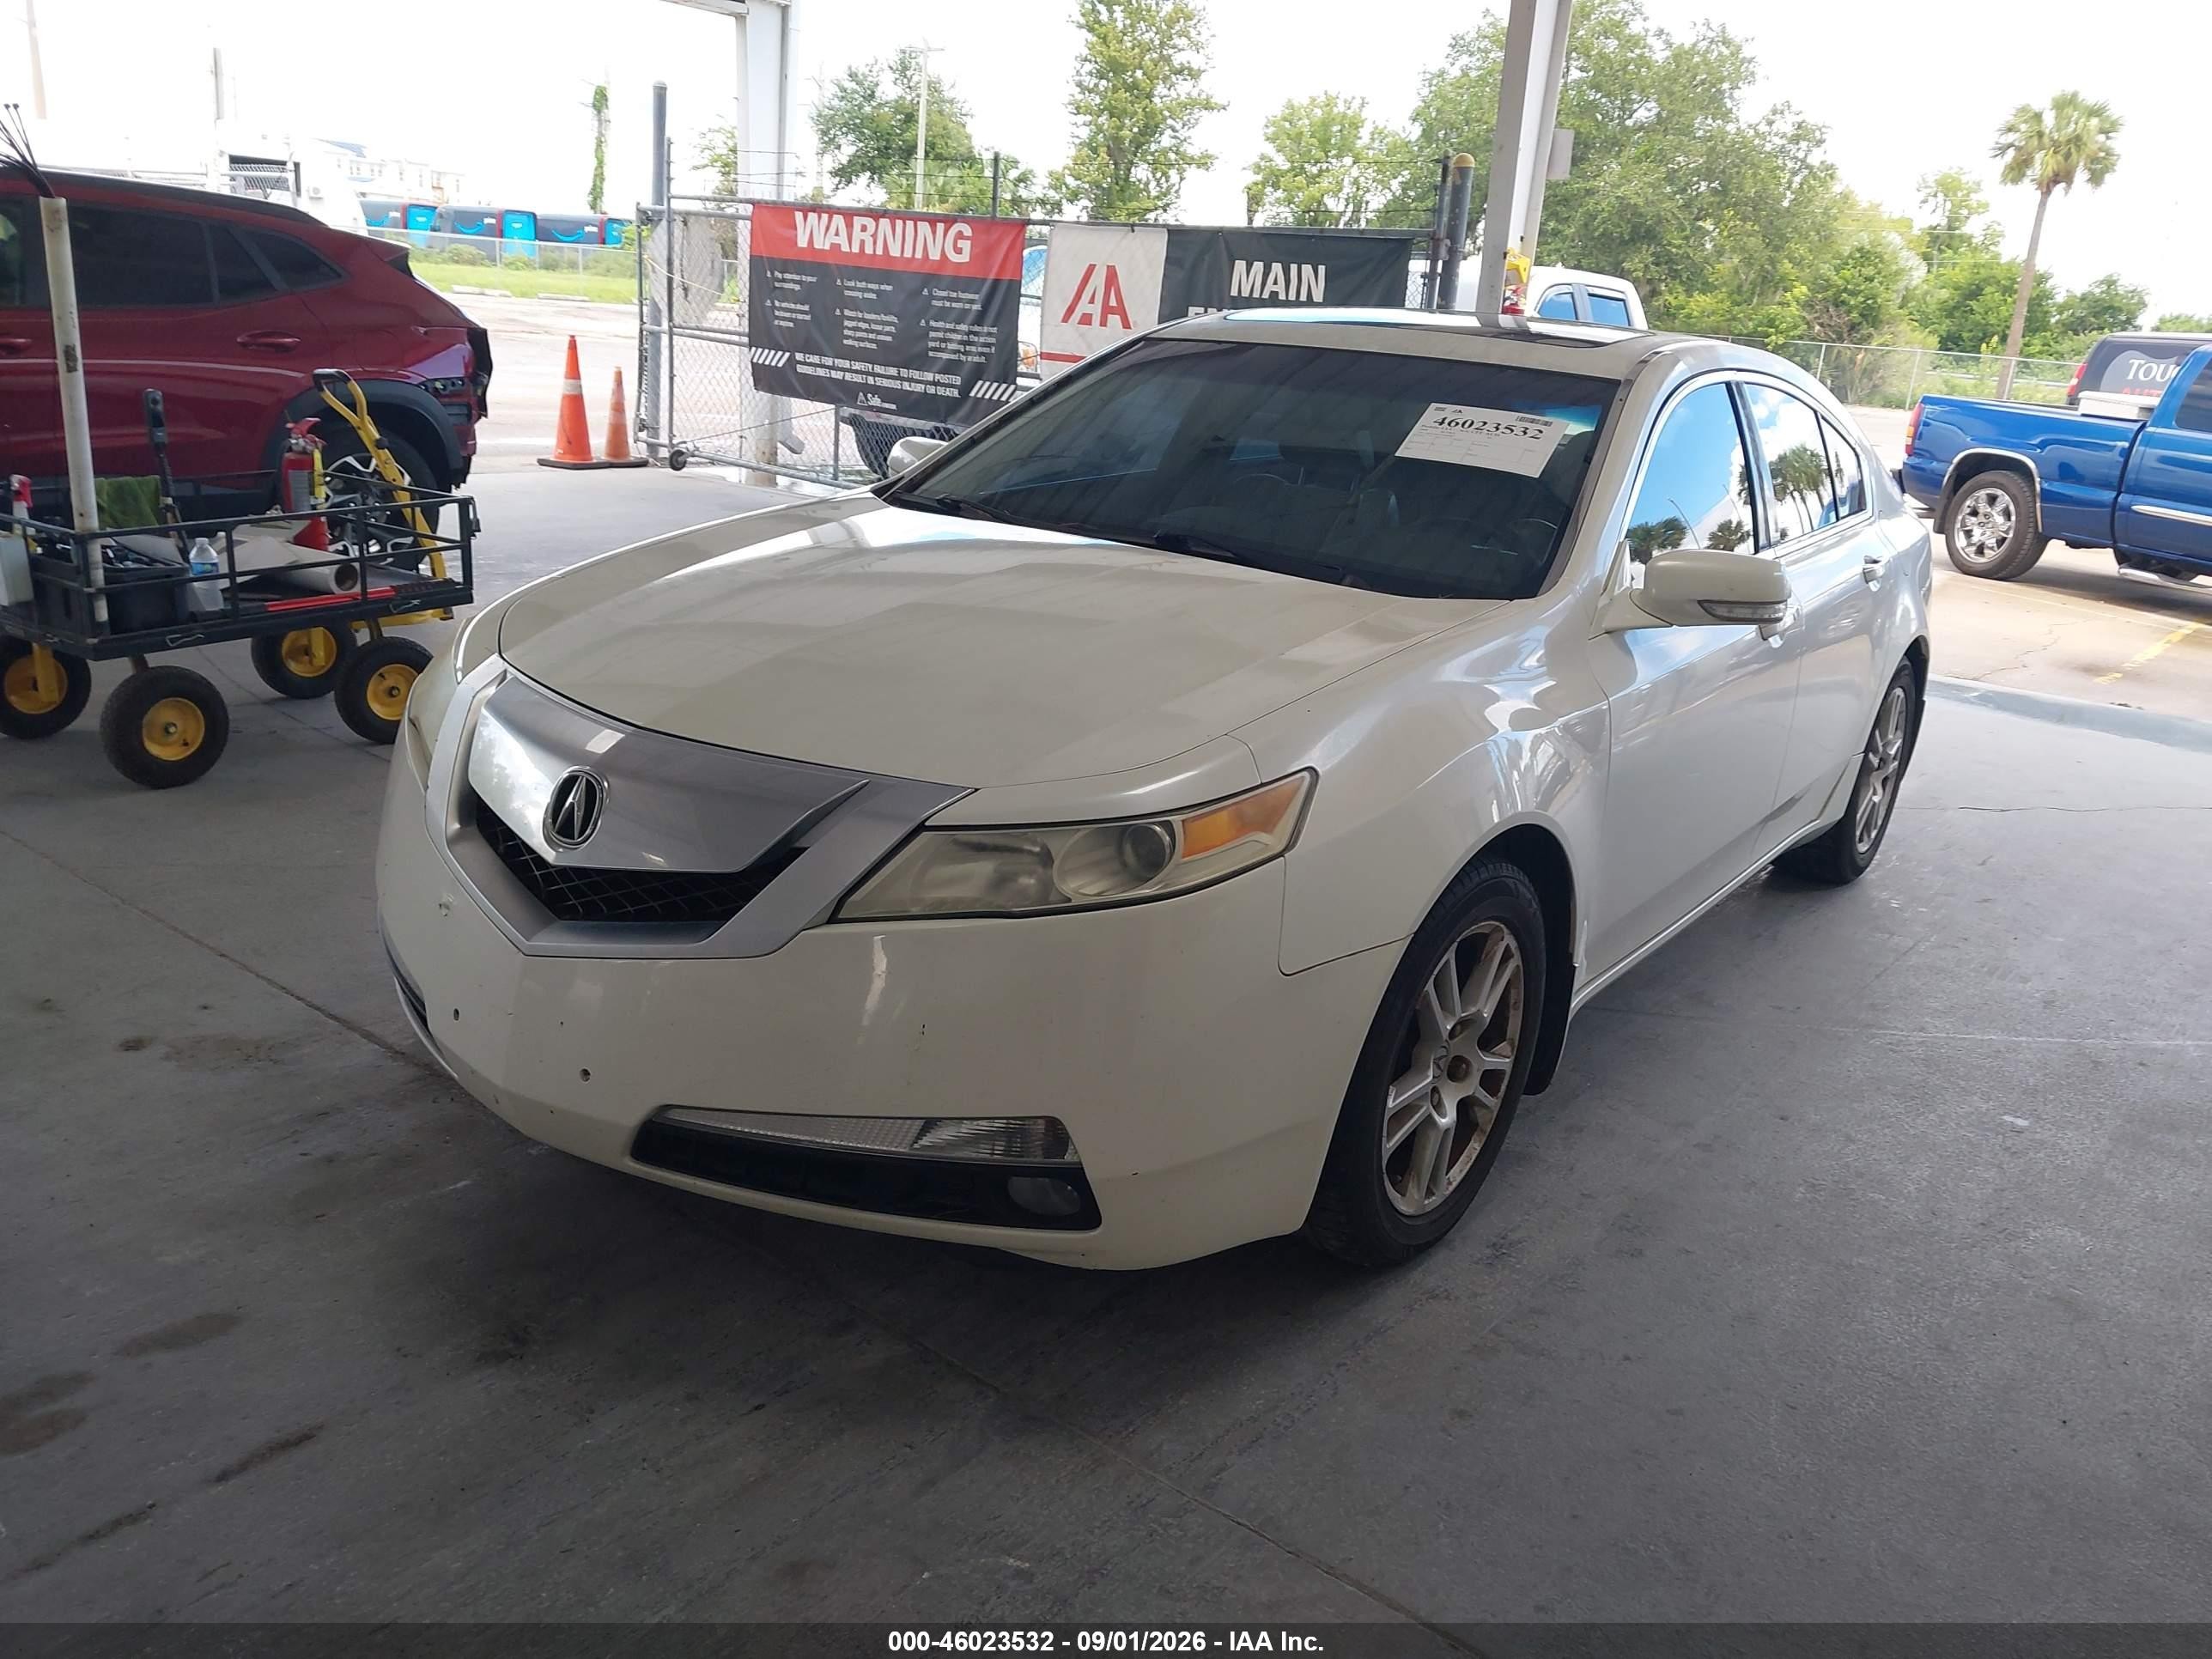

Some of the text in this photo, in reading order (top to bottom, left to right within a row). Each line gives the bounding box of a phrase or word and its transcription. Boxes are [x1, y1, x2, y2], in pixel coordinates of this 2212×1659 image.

[794, 211, 973, 263] WARNING
[1230, 259, 1327, 302] MAIN
[795, 352, 805, 362] WE
[805, 354, 821, 364] CARE
[822, 356, 833, 366] FOR
[835, 358, 850, 368] YOUR
[874, 364, 899, 376] FAILURE
[900, 368, 908, 378] TO
[909, 369, 933, 381] FOLLOW
[935, 373, 961, 385] POSTED
[796, 364, 830, 378] GUIDELINES
[830, 369, 844, 380] MAY
[844, 372, 866, 383] RESULT
[867, 376, 875, 385] IN
[875, 377, 902, 389] SERIOUS
[902, 381, 926, 392] INJURY
[926, 385, 936, 394] OR
[1433, 416, 1544, 441] 46023532
